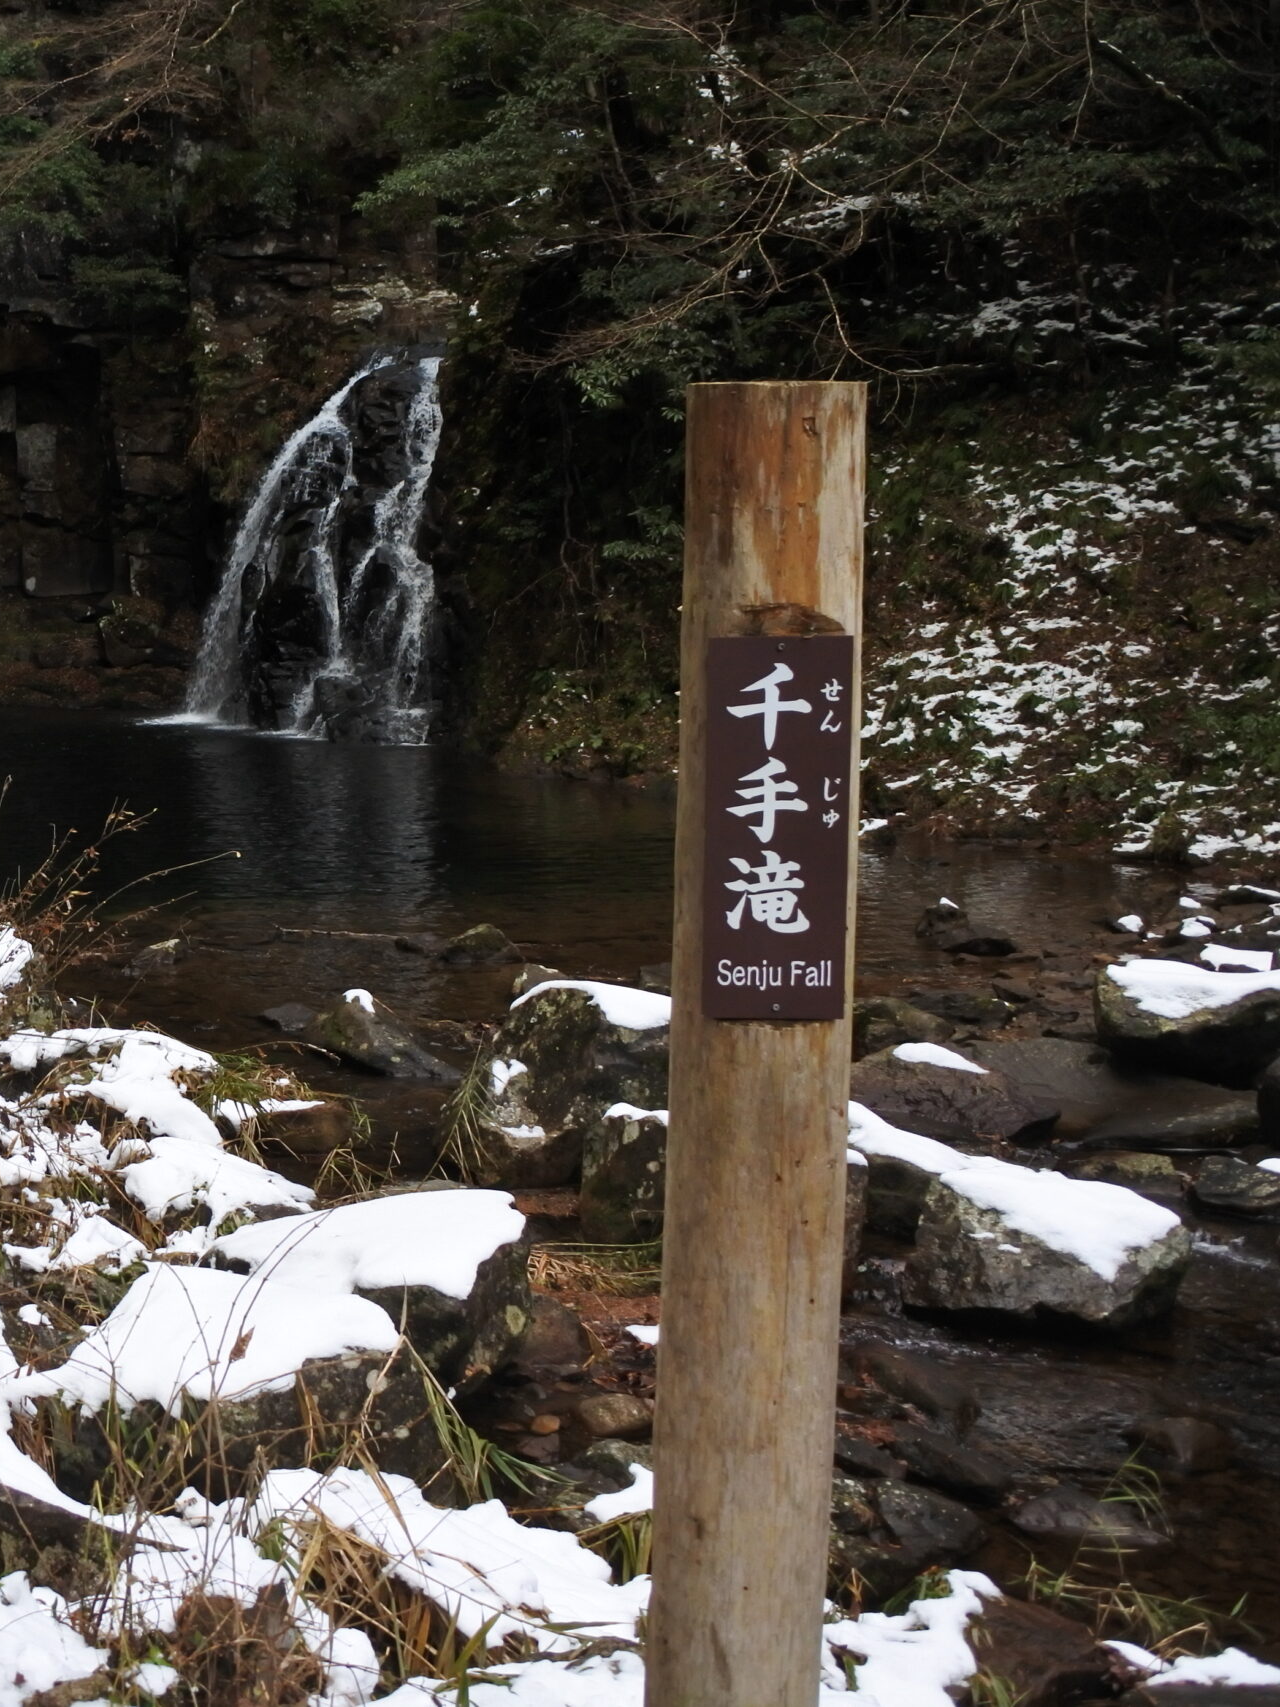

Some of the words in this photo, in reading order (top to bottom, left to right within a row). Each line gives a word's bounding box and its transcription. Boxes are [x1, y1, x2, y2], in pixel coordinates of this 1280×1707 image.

[819, 678, 844, 733] せん
[724, 661, 813, 935] 千手滝
[822, 776, 841, 829] じゅ
[716, 959, 782, 991] Senju
[790, 960, 832, 987] Fall
